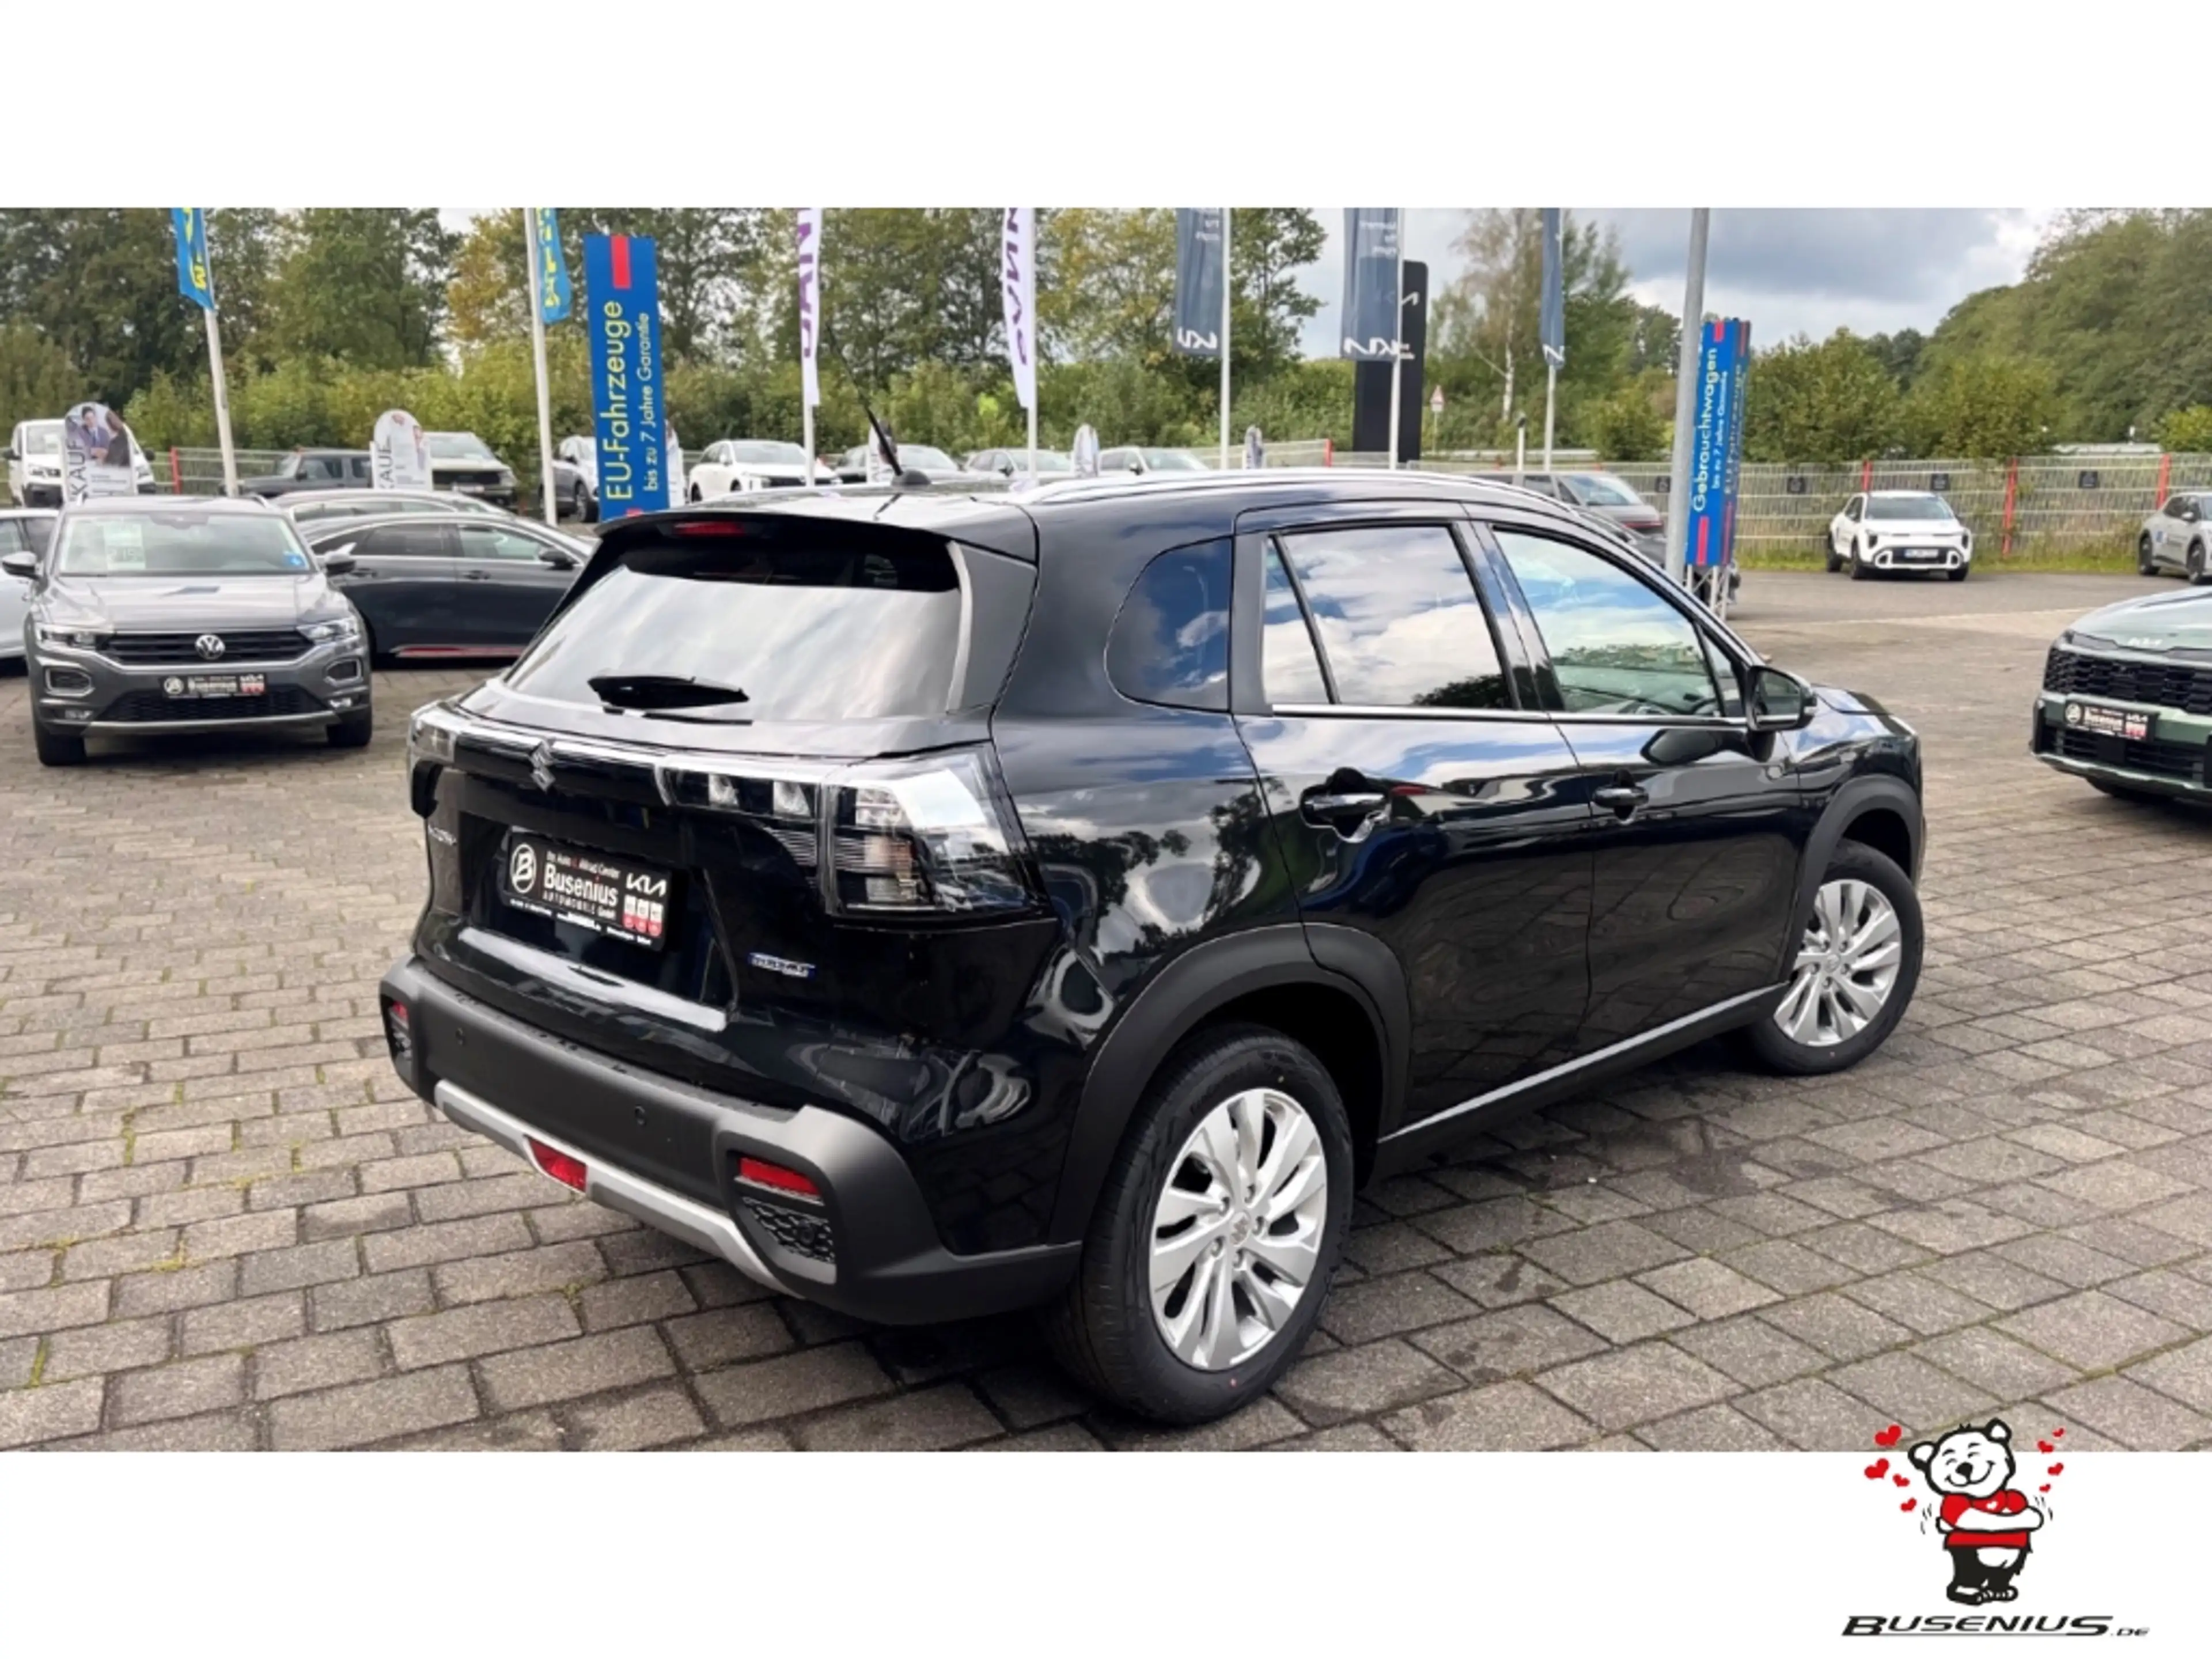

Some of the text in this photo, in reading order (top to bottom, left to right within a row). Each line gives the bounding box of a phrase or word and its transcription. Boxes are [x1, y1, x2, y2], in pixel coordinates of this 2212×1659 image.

[600, 300, 632, 500] EU-Fahrzeuge
[635, 313, 658, 491] bis zu 7 Jahre Garantie
[1692, 347, 1719, 512] Gebrauchtwagen
[544, 863, 619, 907] Busenius
